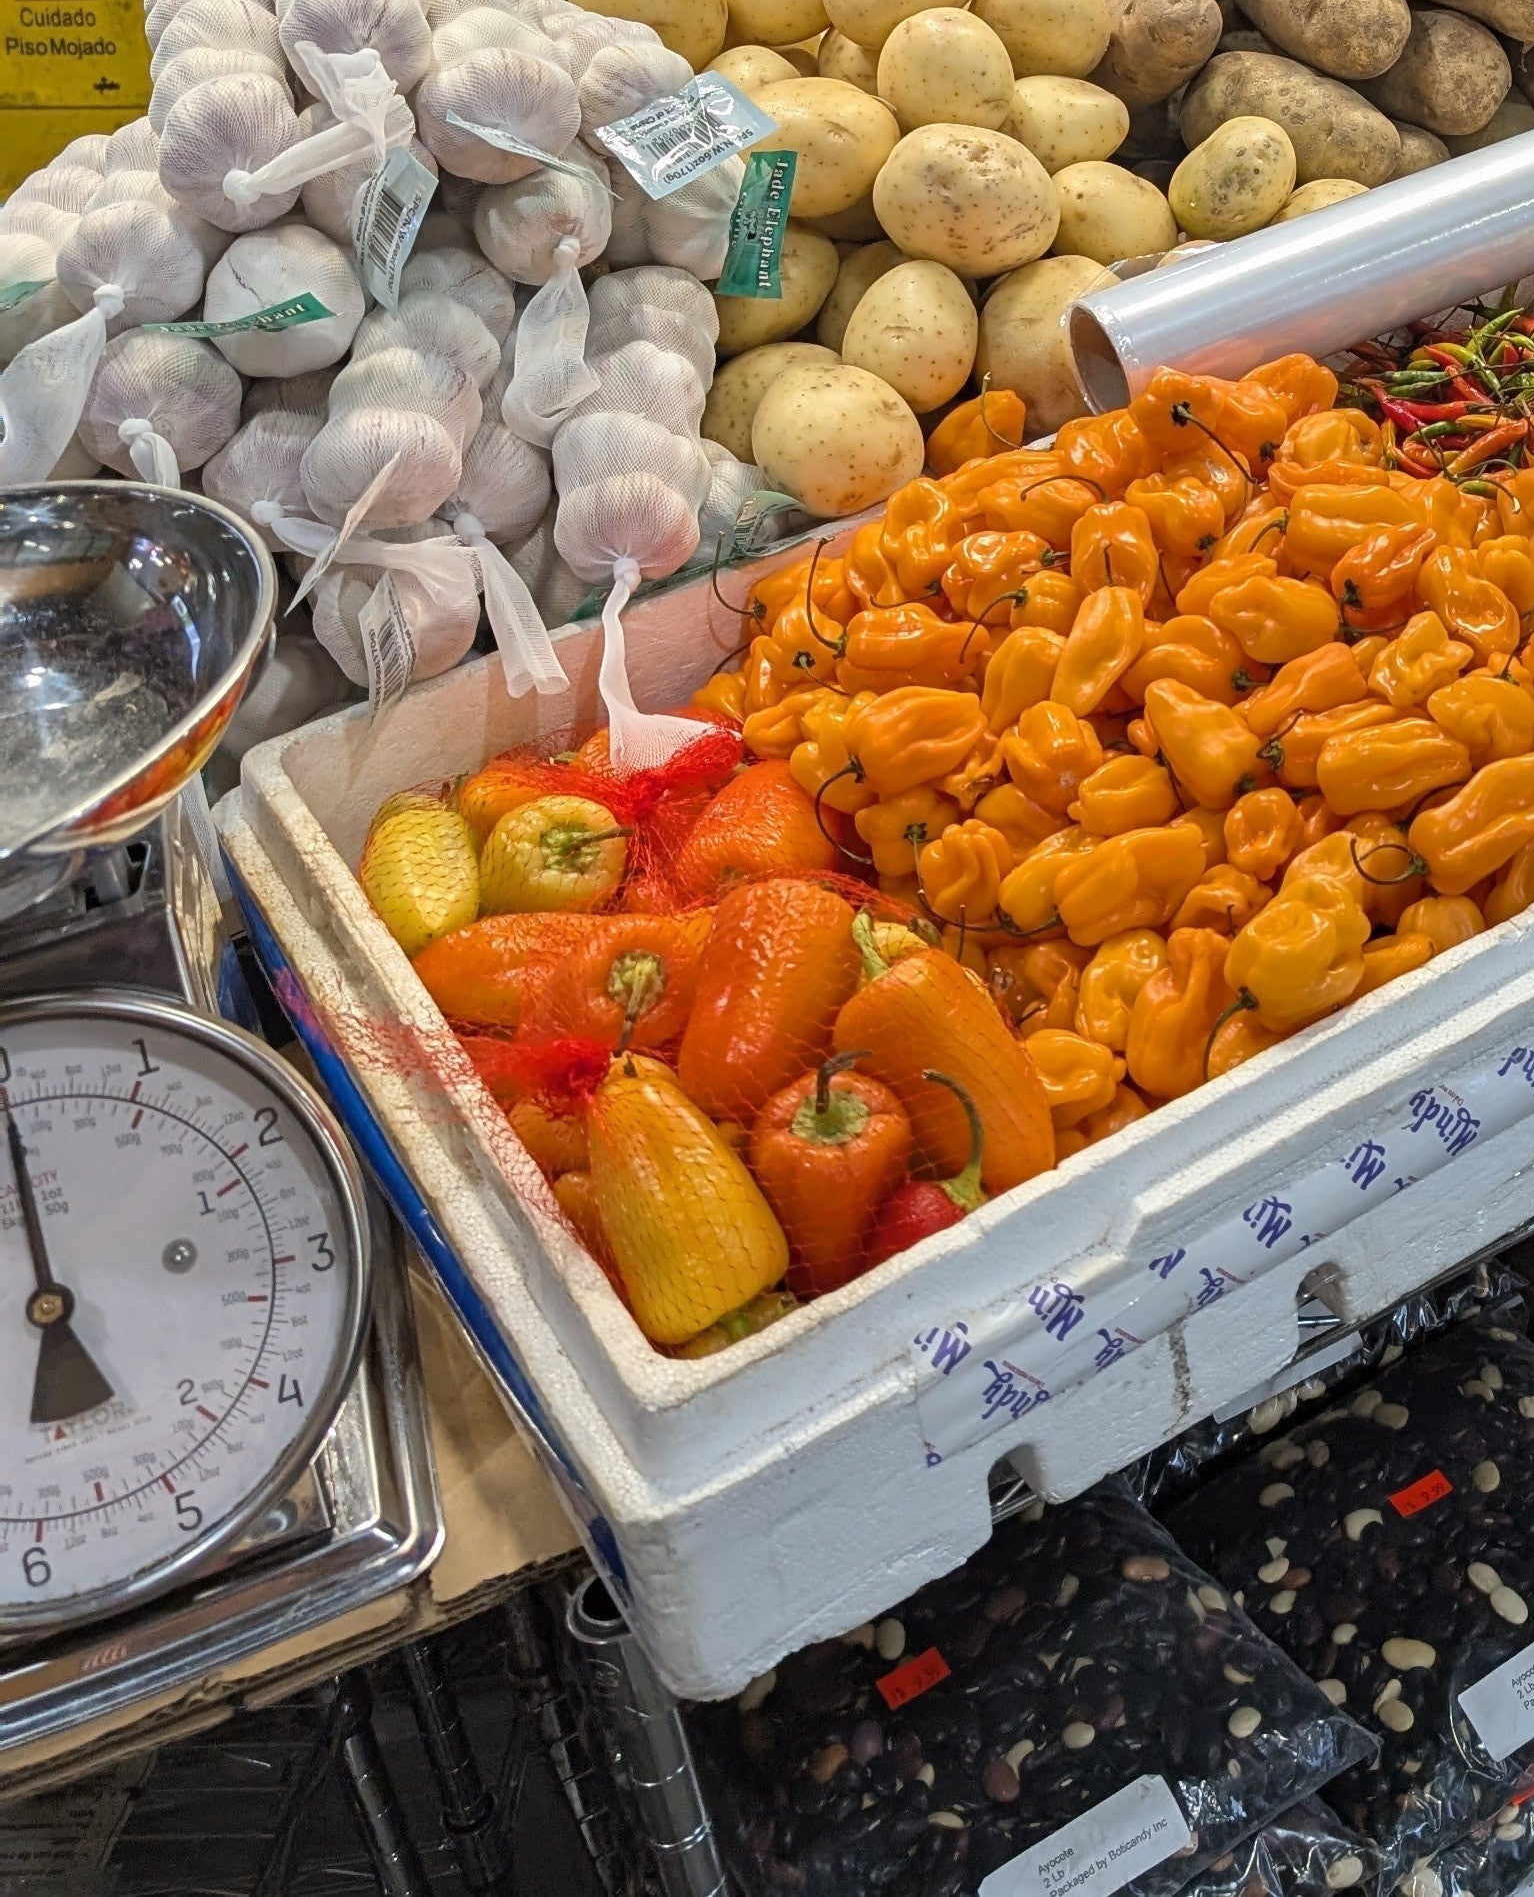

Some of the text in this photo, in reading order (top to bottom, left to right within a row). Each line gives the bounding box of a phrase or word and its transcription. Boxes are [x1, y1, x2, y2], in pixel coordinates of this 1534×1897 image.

[20, 7, 96, 27] Cuidado
[5, 38, 117, 60] Piso Mojado
[757, 158, 788, 289] Jade Elephant
[132, 1038, 159, 1076] 1
[254, 1107, 284, 1147] 2
[1409, 1087, 1480, 1157] Mindy
[197, 1190, 215, 1216] 1
[307, 1232, 336, 1272] 3
[177, 1378, 198, 1406] 2
[278, 1374, 304, 1407] 4
[174, 1490, 202, 1532] 5
[22, 1546, 51, 1587] 6
[1516, 1689, 1525, 1700] 2
[1037, 1847, 1075, 1876] Ayocote
[1049, 1817, 1168, 1897] Packaged by Boticandy Inc
[1042, 1869, 1066, 1889] 2 Lb
